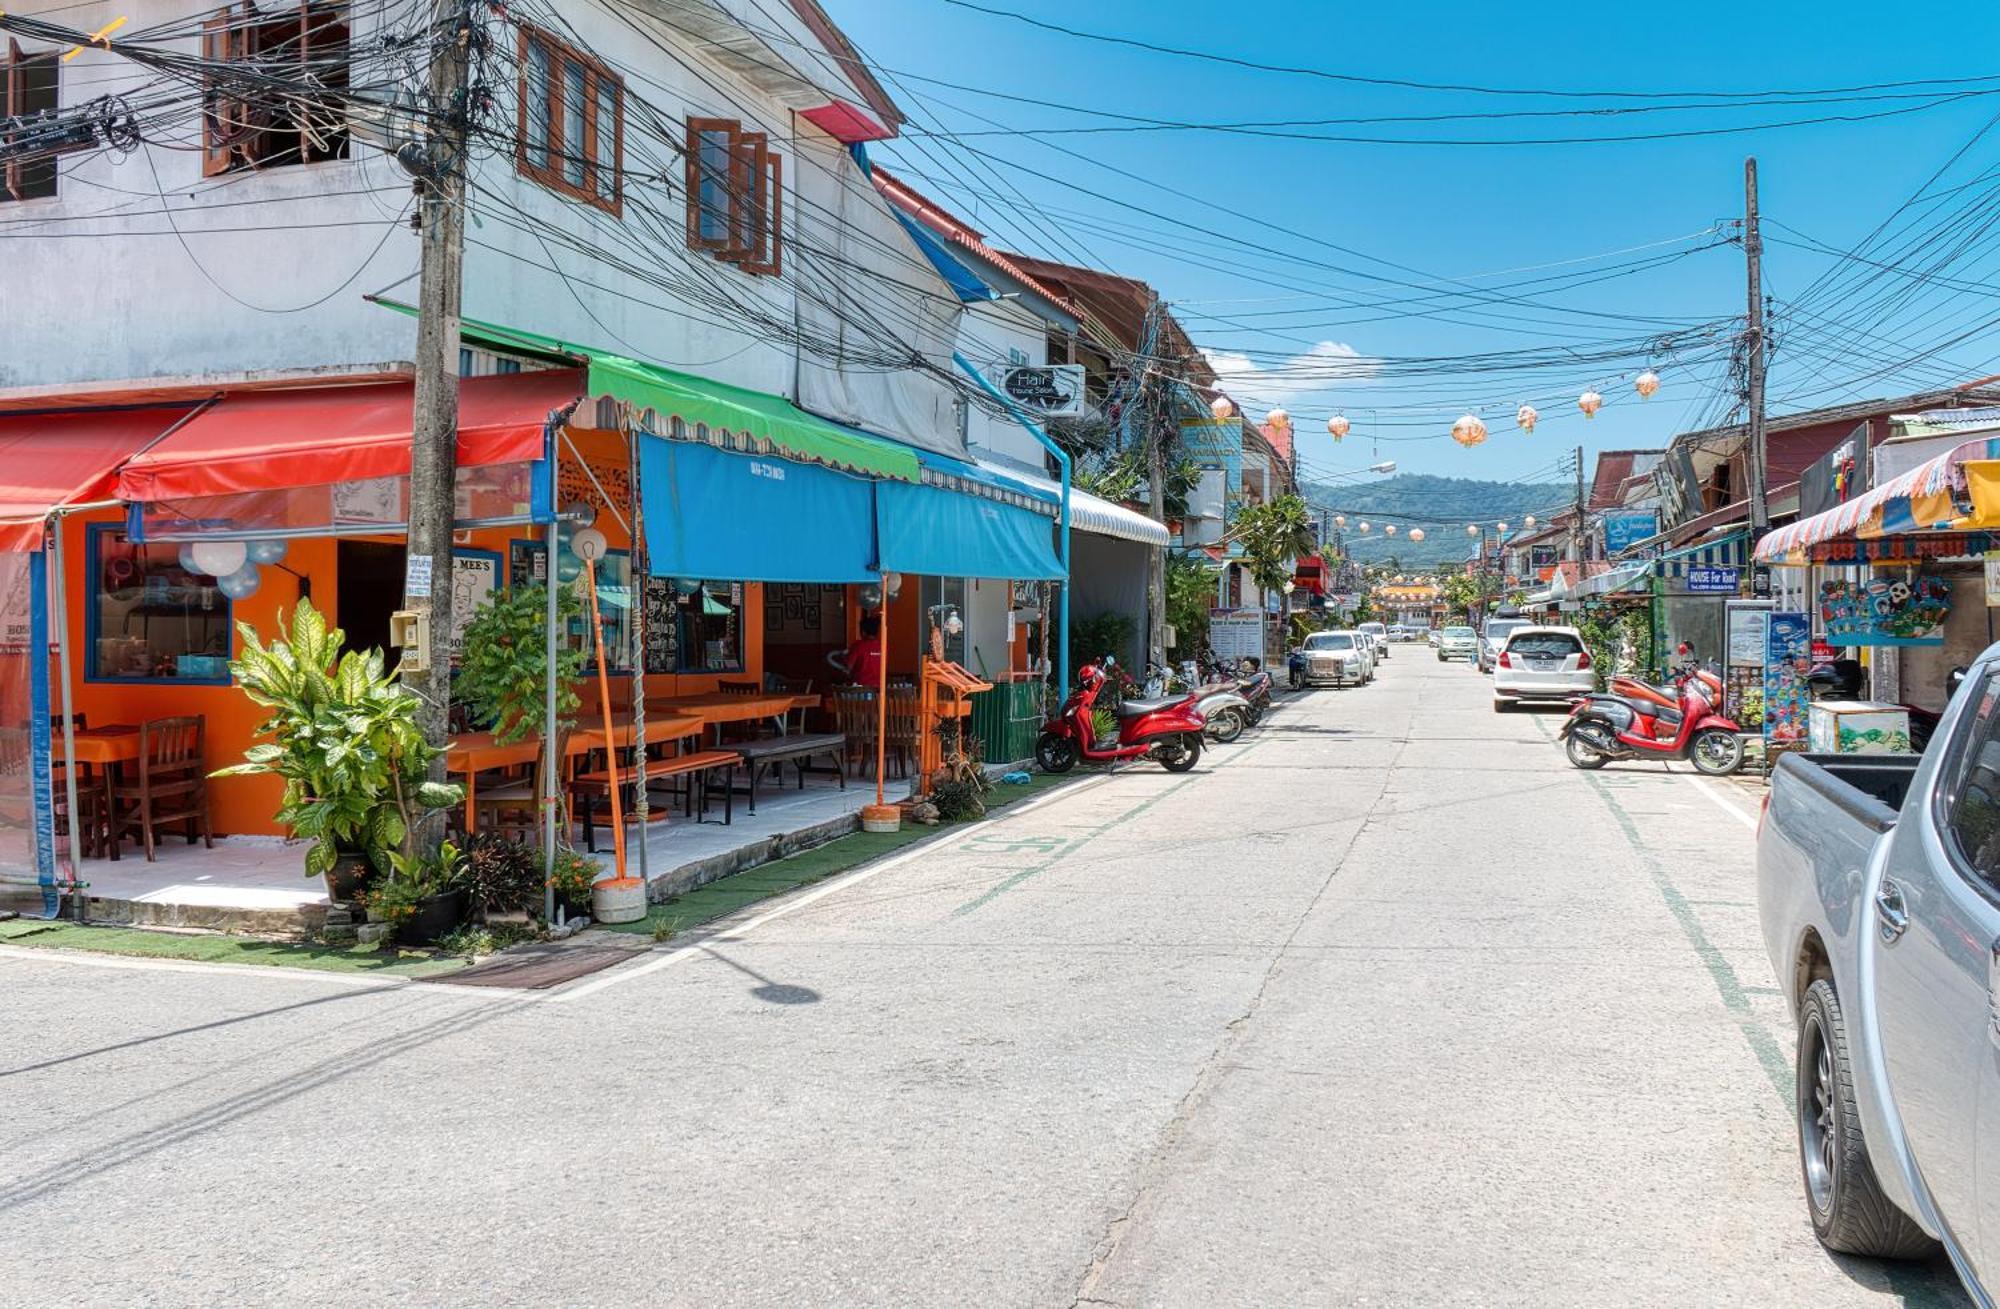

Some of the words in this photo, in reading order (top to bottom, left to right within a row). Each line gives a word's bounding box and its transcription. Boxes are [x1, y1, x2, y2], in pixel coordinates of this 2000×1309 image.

[1018, 373, 1048, 386] Hair
[459, 559, 490, 571] MEE'S
[1690, 571, 1710, 583] HOUSE
[1711, 571, 1721, 583] For
[1722, 570, 1736, 583] Rent
